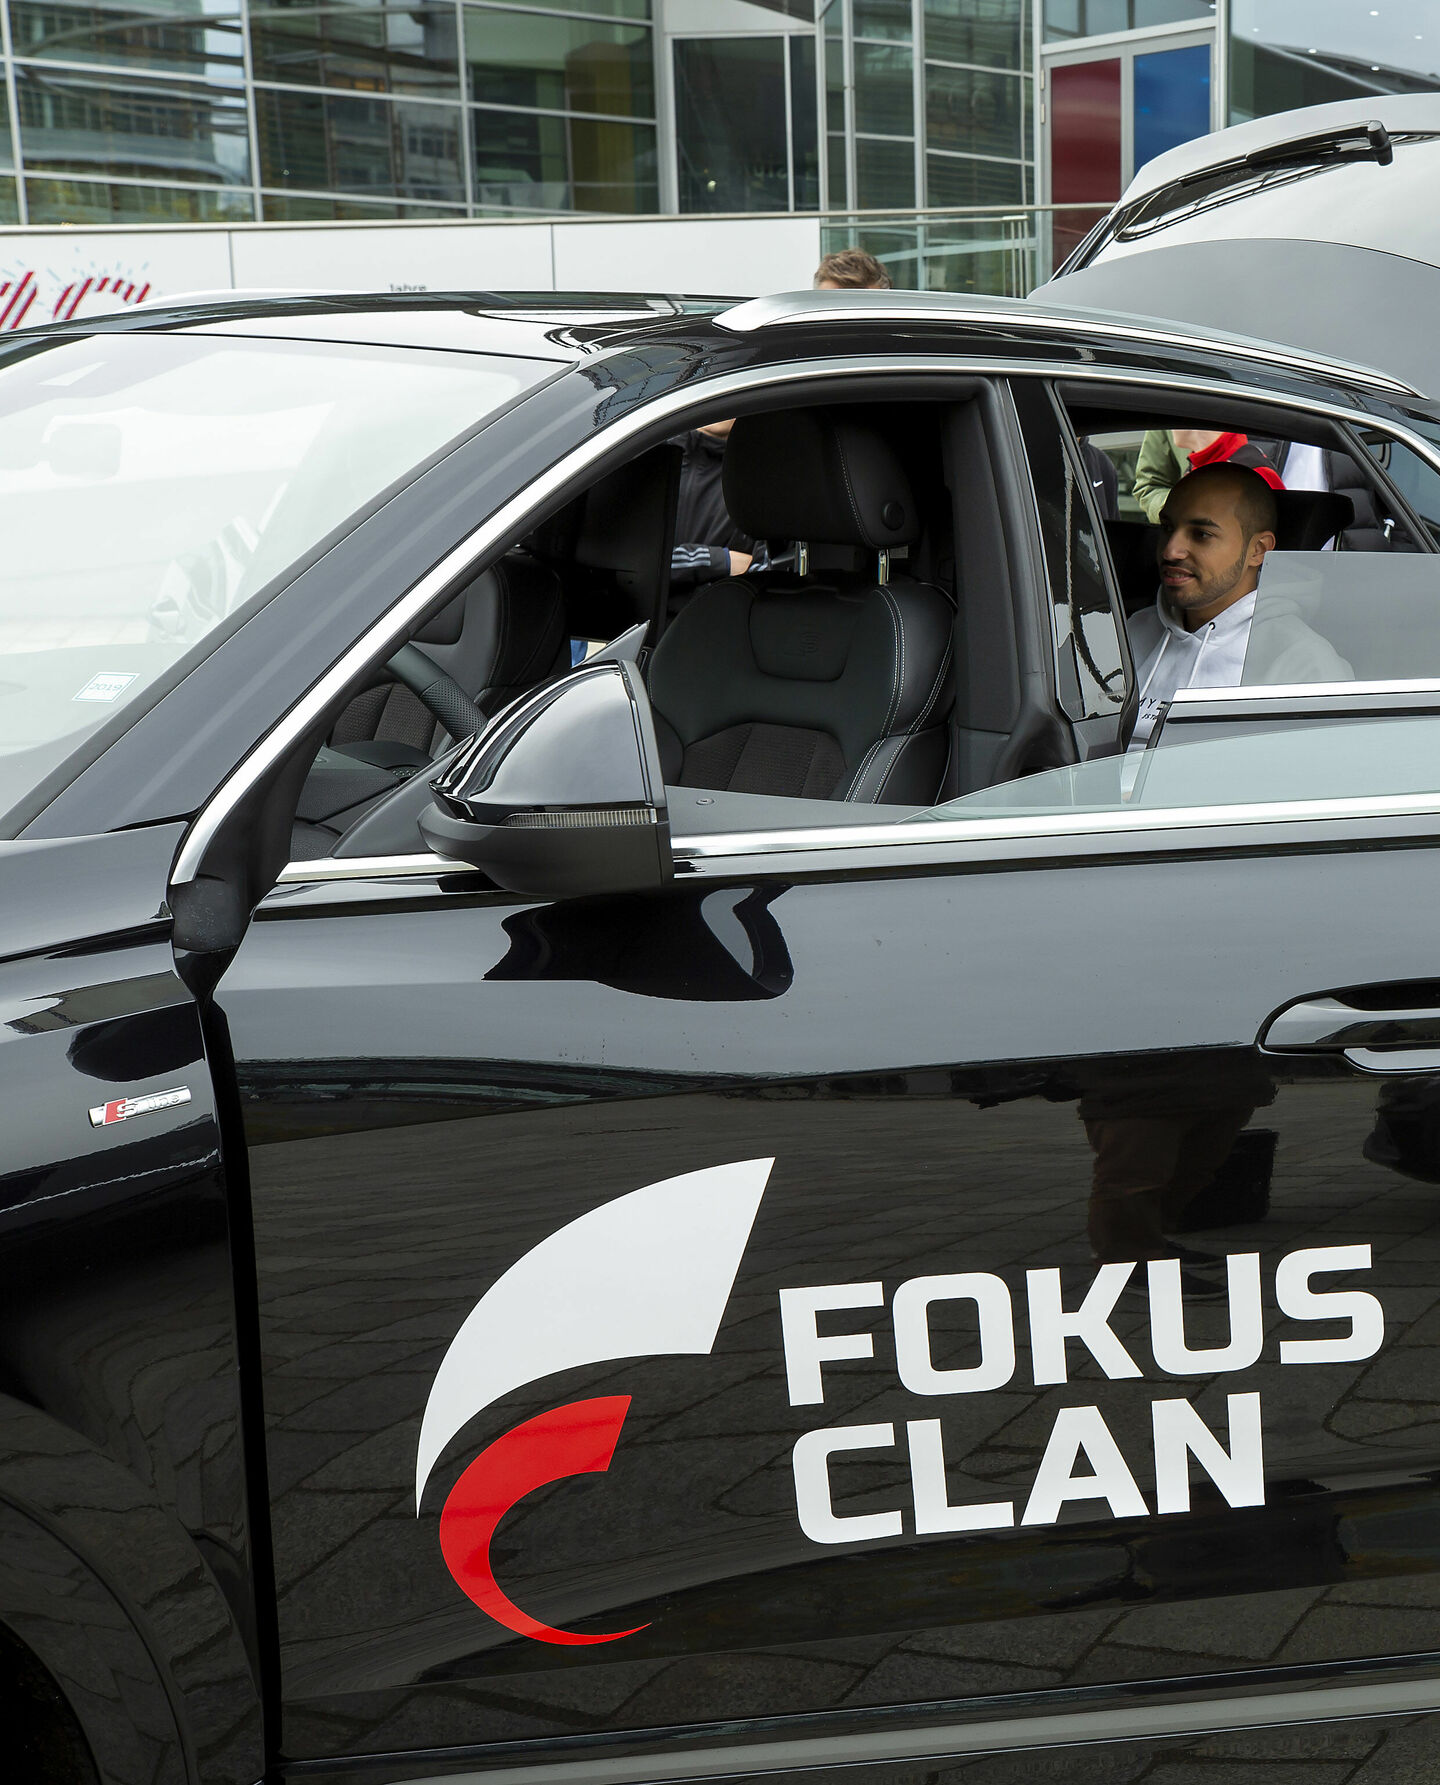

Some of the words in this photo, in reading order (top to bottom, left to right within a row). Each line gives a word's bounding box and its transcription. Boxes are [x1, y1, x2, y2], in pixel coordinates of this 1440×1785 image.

[115, 1102, 137, 1119] S
[147, 1094, 180, 1110] line
[779, 1244, 1385, 1407] FOKUS
[792, 1391, 1266, 1544] CLAN
